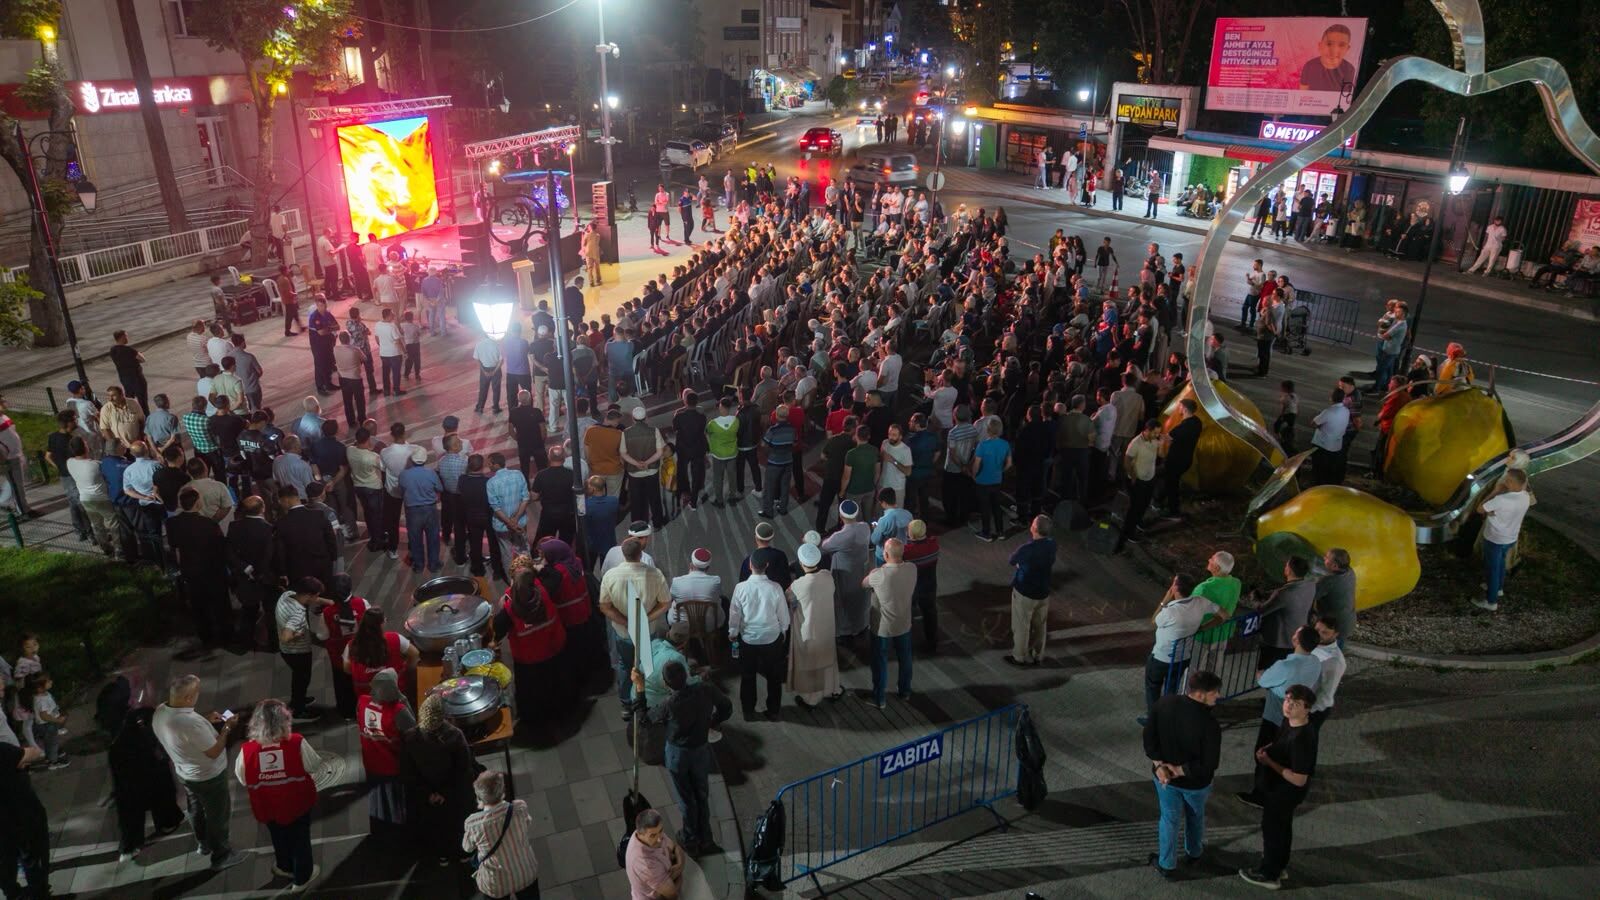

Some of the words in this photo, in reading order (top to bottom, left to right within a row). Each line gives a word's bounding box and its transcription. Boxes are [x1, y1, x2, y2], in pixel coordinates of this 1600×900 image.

[1223, 41, 1251, 49] AHMET
[1224, 33, 1241, 41] BEN
[1118, 104, 1153, 119] MEYDAN
[1152, 107, 1178, 121] PARK
[1274, 126, 1321, 142] MEYDA
[882, 738, 941, 775] ZABITA
